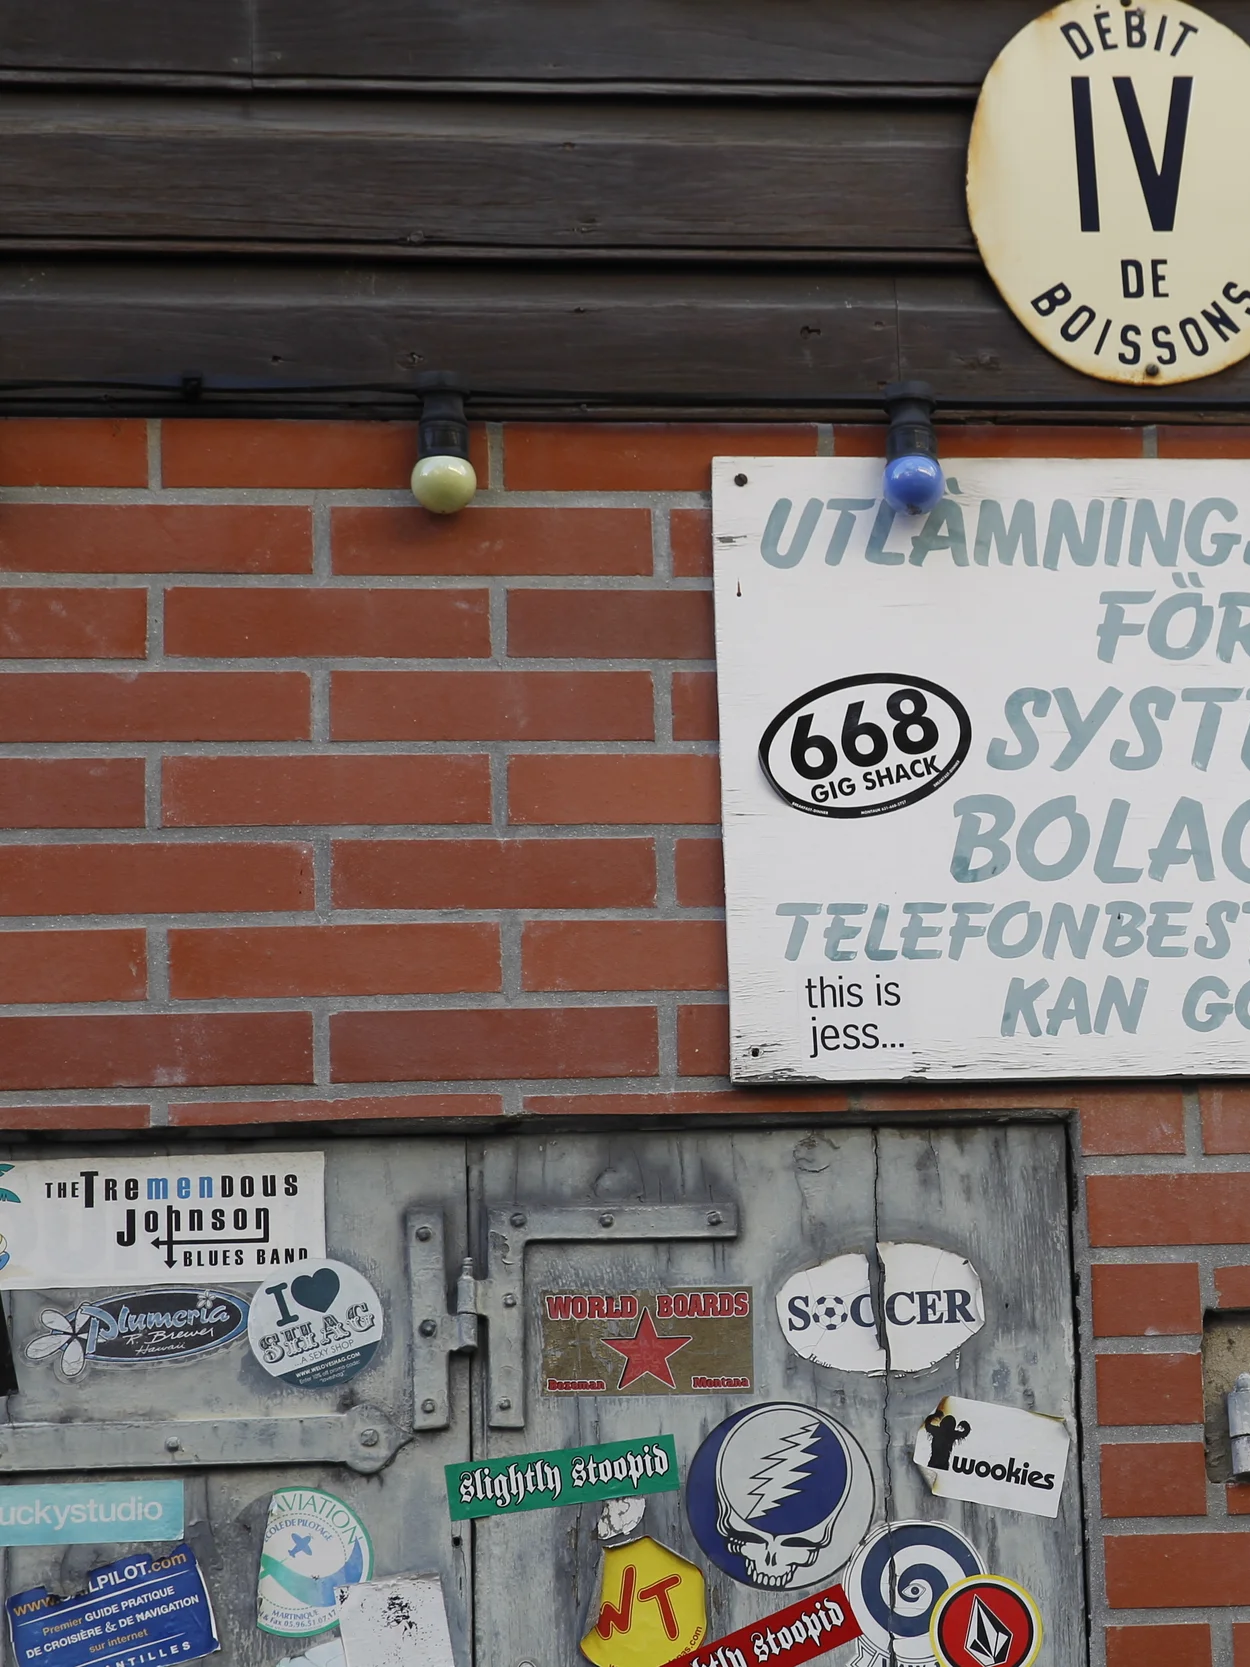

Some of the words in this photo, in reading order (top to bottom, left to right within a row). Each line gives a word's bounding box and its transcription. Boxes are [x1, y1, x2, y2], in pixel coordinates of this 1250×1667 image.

[1060, 4, 1198, 61] DÉBIT
[1071, 76, 1193, 232] IV
[1120, 259, 1169, 299] DE
[790, 688, 939, 780] 668
[811, 777, 856, 803] GIG
[863, 755, 942, 791] SHACK
[805, 976, 863, 1008] this
[875, 974, 901, 1007] is
[1000, 975, 1149, 1037] KAN
[808, 1017, 905, 1058] jess...
[45, 1182, 79, 1199] THE
[183, 1249, 244, 1267] BLUES
[265, 1282, 299, 1327] I
[546, 1294, 639, 1320] WORLD
[655, 1291, 750, 1318] BOARDS
[81, 1304, 231, 1354] Plumeria
[259, 1302, 376, 1364] SHAG
[308, 1347, 330, 1362] SEXY
[331, 1339, 354, 1353] SHOP
[692, 1375, 750, 1389] Montana
[297, 1518, 333, 1541] PILOTAGE
[26, 1645, 42, 1659] DE
[44, 1626, 103, 1653] CROISIÈRE
[104, 1621, 117, 1633] &
[118, 1616, 134, 1629] DE
[136, 1594, 200, 1622] NAVIGATION
[42, 1616, 83, 1637] Premier
[84, 1605, 120, 1622] GUIDE
[121, 1585, 176, 1611] PRATIQUE
[272, 1609, 319, 1621] MARTINIQUE
[89, 1641, 106, 1653] sur
[107, 1628, 149, 1648] internet
